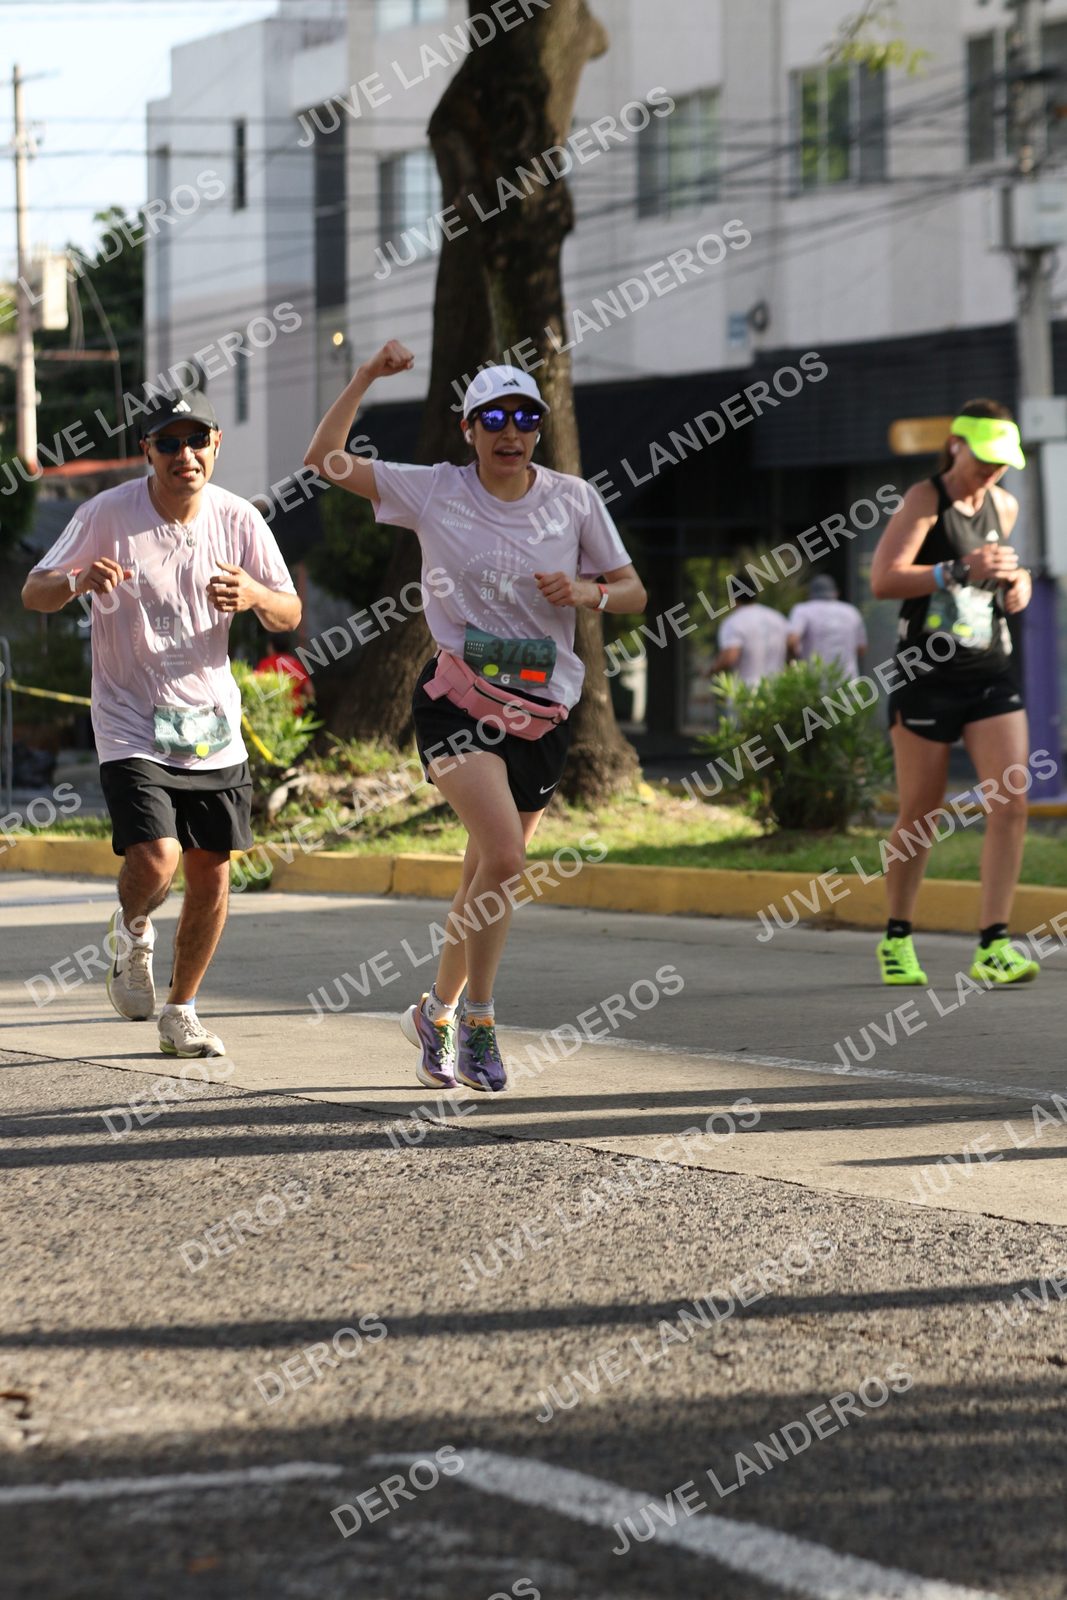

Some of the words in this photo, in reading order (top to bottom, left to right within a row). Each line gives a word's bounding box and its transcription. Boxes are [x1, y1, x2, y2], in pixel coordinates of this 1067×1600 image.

[481, 569, 497, 583] 15
[480, 587, 494, 600] 30
[499, 572, 521, 605] K
[154, 616, 170, 630] 15
[488, 638, 554, 668] 3763
[501, 674, 511, 684] G
